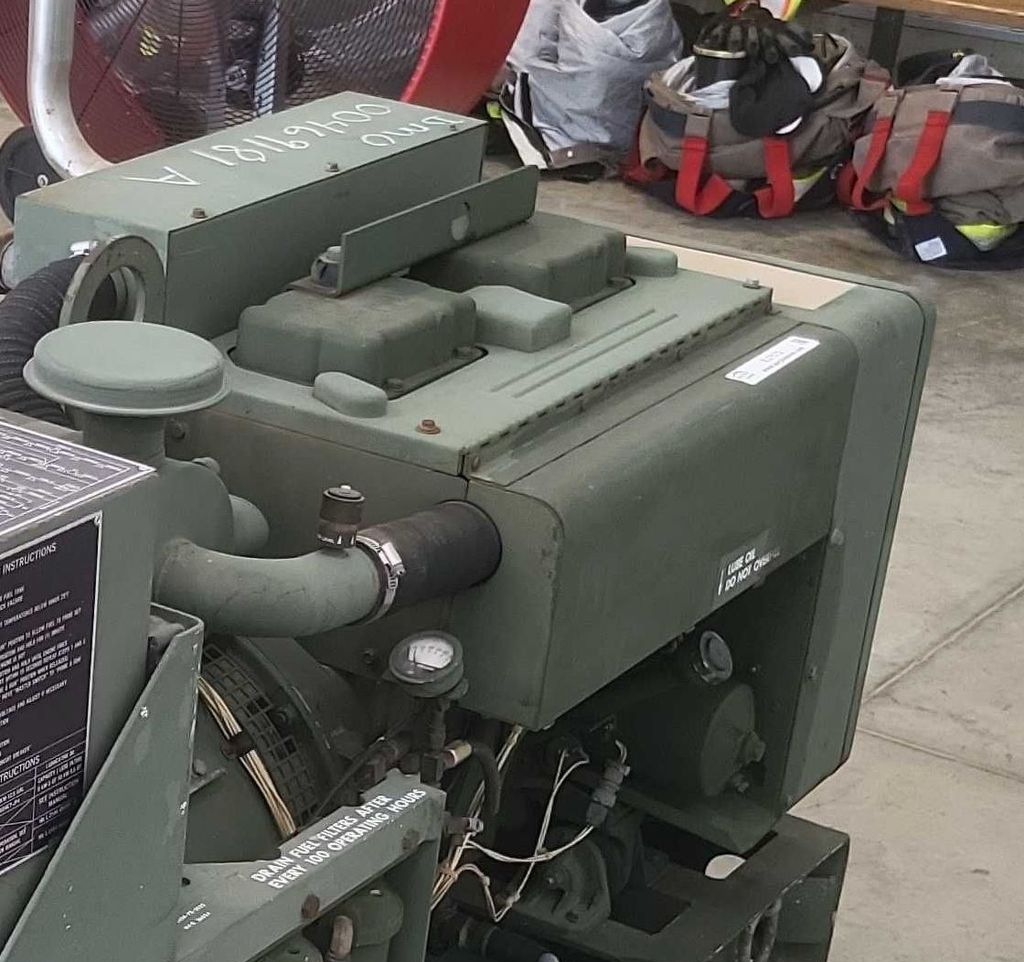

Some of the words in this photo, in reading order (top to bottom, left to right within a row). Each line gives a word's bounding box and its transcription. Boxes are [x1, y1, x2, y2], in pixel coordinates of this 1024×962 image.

[2, 542, 57, 575] INSTRUCTIONS
[251, 856, 291, 883] DRAIN
[289, 838, 320, 860] FUEL
[320, 815, 358, 843] FILTERS
[356, 795, 393, 819] AFTER
[268, 864, 307, 890] EVERY
[304, 850, 330, 867] 100
[328, 811, 390, 851] OPERATING
[387, 788, 427, 814] HOURS
